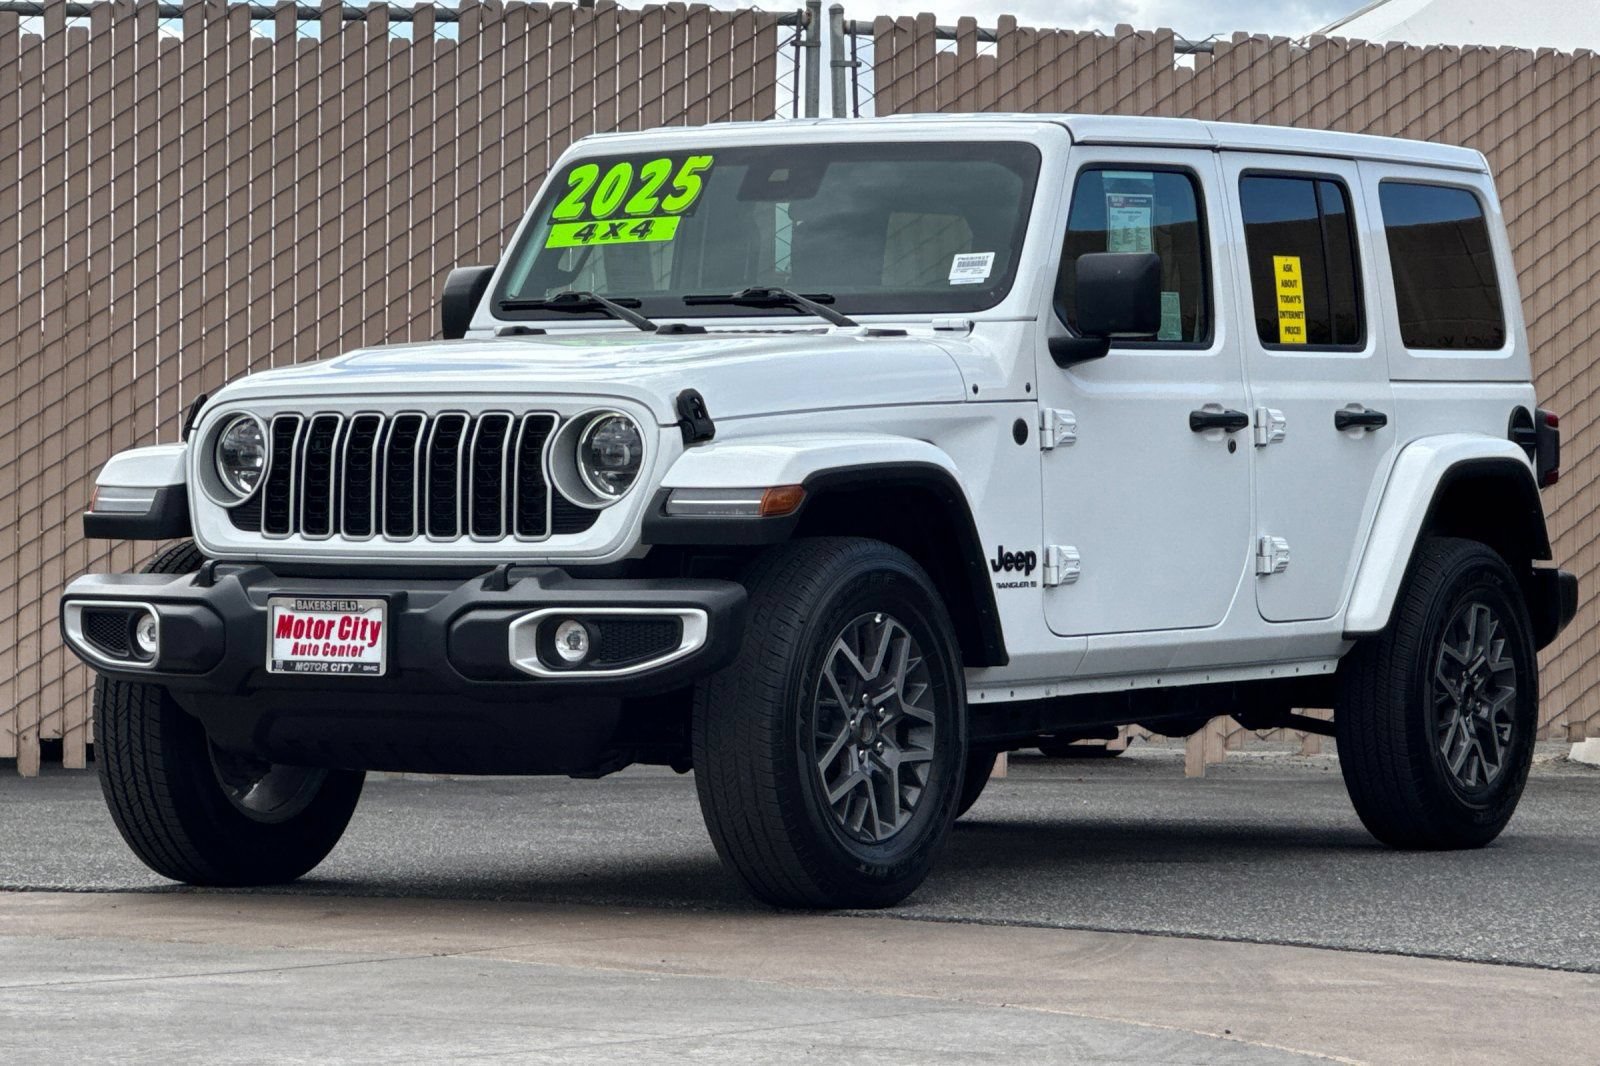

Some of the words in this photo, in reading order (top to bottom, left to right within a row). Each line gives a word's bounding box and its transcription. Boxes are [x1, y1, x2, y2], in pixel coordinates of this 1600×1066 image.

[552, 155, 713, 219] 2025
[1283, 264, 1293, 272] ASK
[1281, 280, 1297, 288] ABOUT
[1280, 295, 1301, 304] TODAY'S
[1279, 311, 1304, 319] INTERNET
[990, 545, 1037, 577] Jeep
[296, 600, 357, 611] BAKERSFIELD
[275, 614, 336, 640] Motor
[338, 615, 382, 648] City
[291, 641, 320, 657] Auto
[322, 642, 365, 658] Center
[295, 662, 328, 672] MOTOR
[330, 663, 354, 672] CITY
